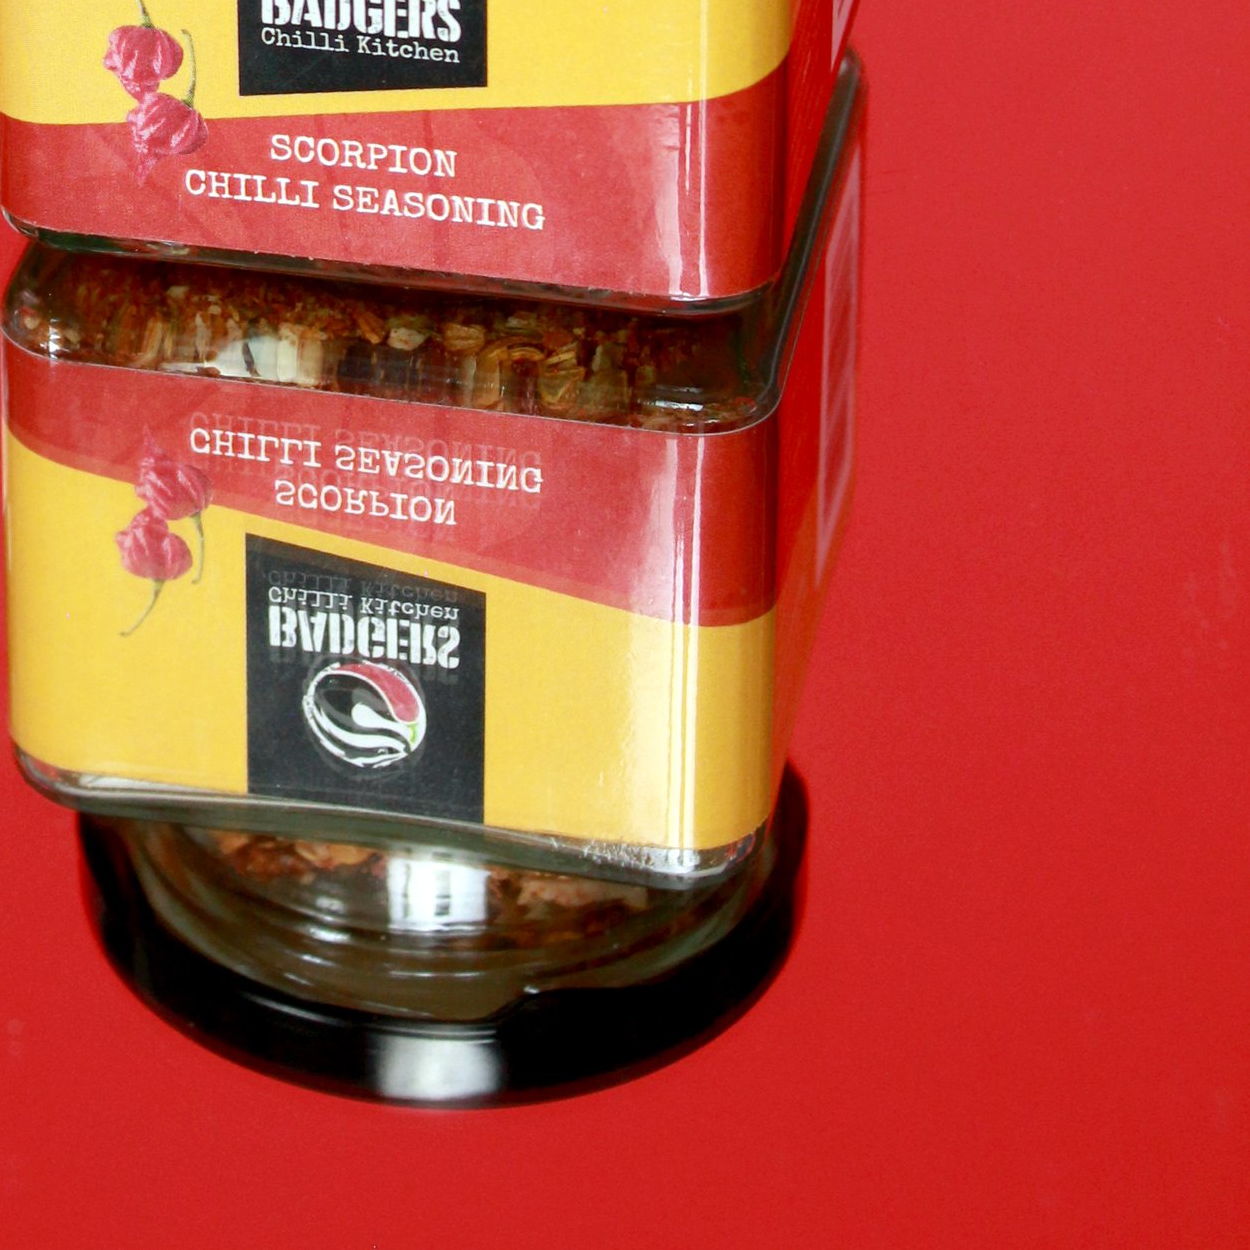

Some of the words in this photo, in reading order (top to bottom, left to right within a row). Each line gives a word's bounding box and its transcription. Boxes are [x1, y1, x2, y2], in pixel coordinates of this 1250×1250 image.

[260, 26, 349, 53] Chilli
[357, 35, 461, 63] Kitchen
[270, 134, 457, 178] SCORPION
[184, 169, 320, 208] CHILLI
[332, 184, 546, 231] SEASONING
